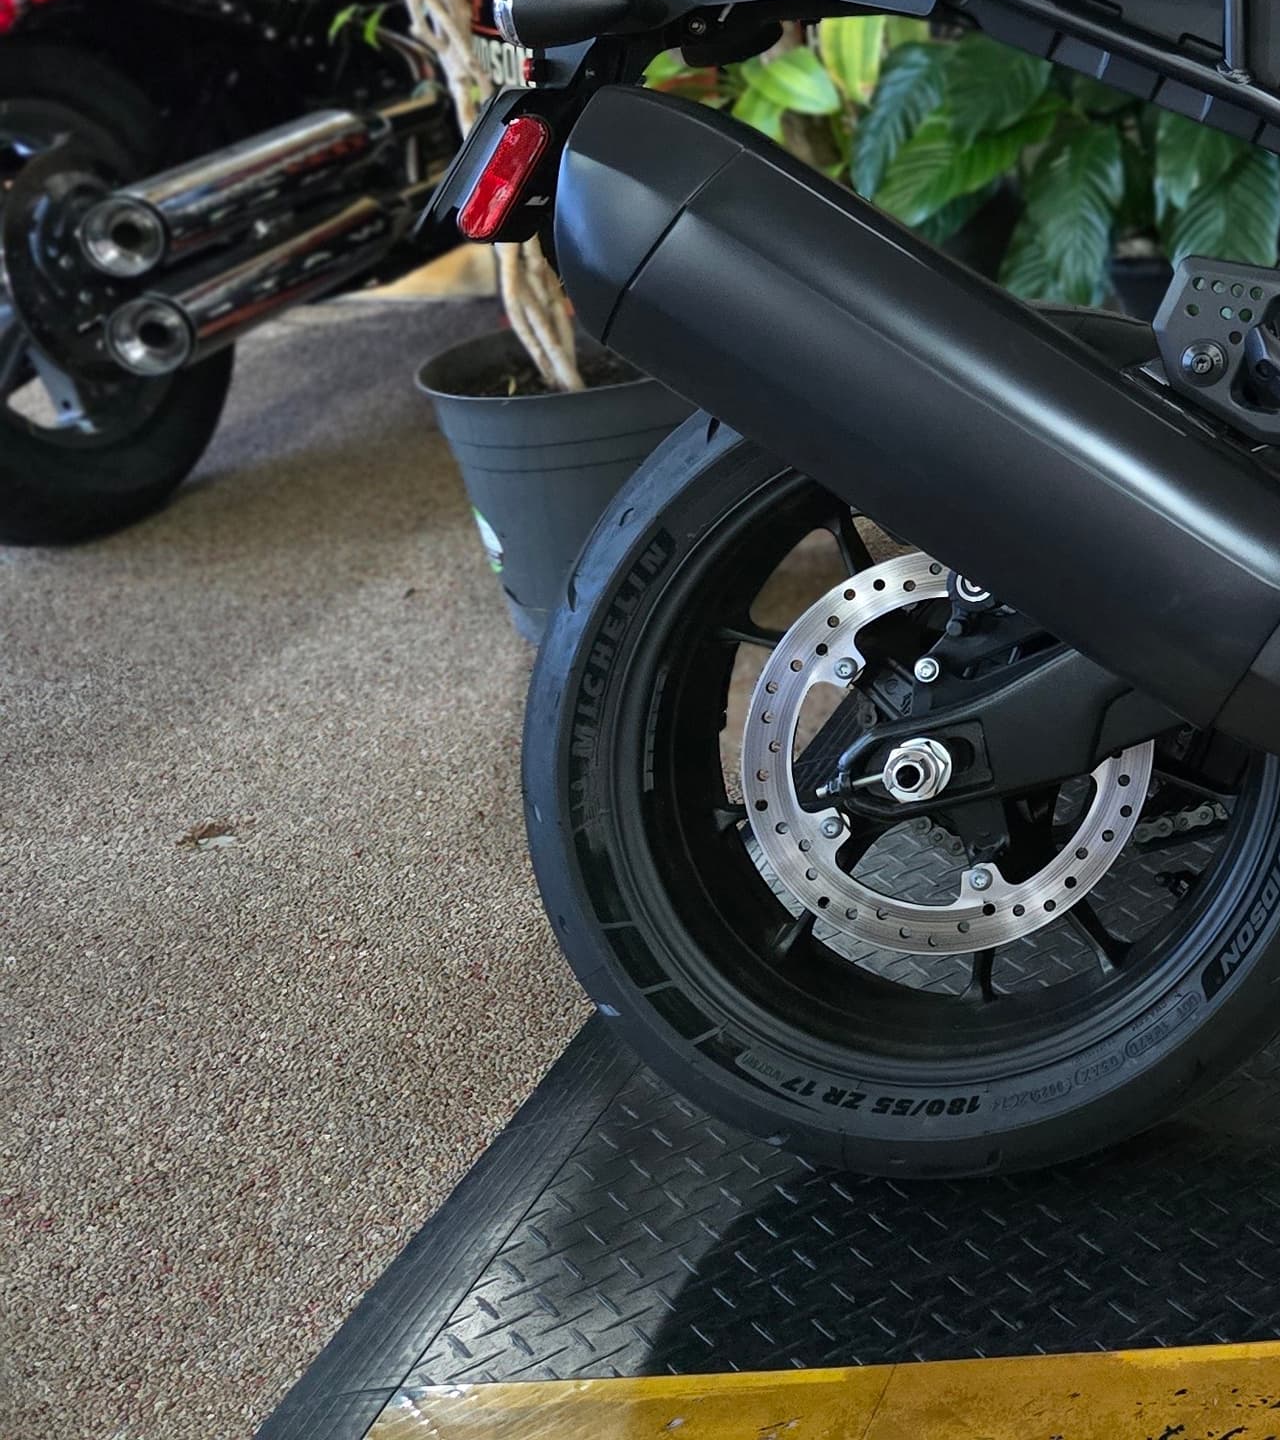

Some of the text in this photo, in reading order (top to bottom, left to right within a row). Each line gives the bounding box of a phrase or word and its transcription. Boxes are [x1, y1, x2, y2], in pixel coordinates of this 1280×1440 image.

[571, 540, 667, 758] MICHELIN
[780, 1075, 817, 1097] 17
[822, 1086, 867, 1110] ZR
[872, 1095, 981, 1117] 180/55
